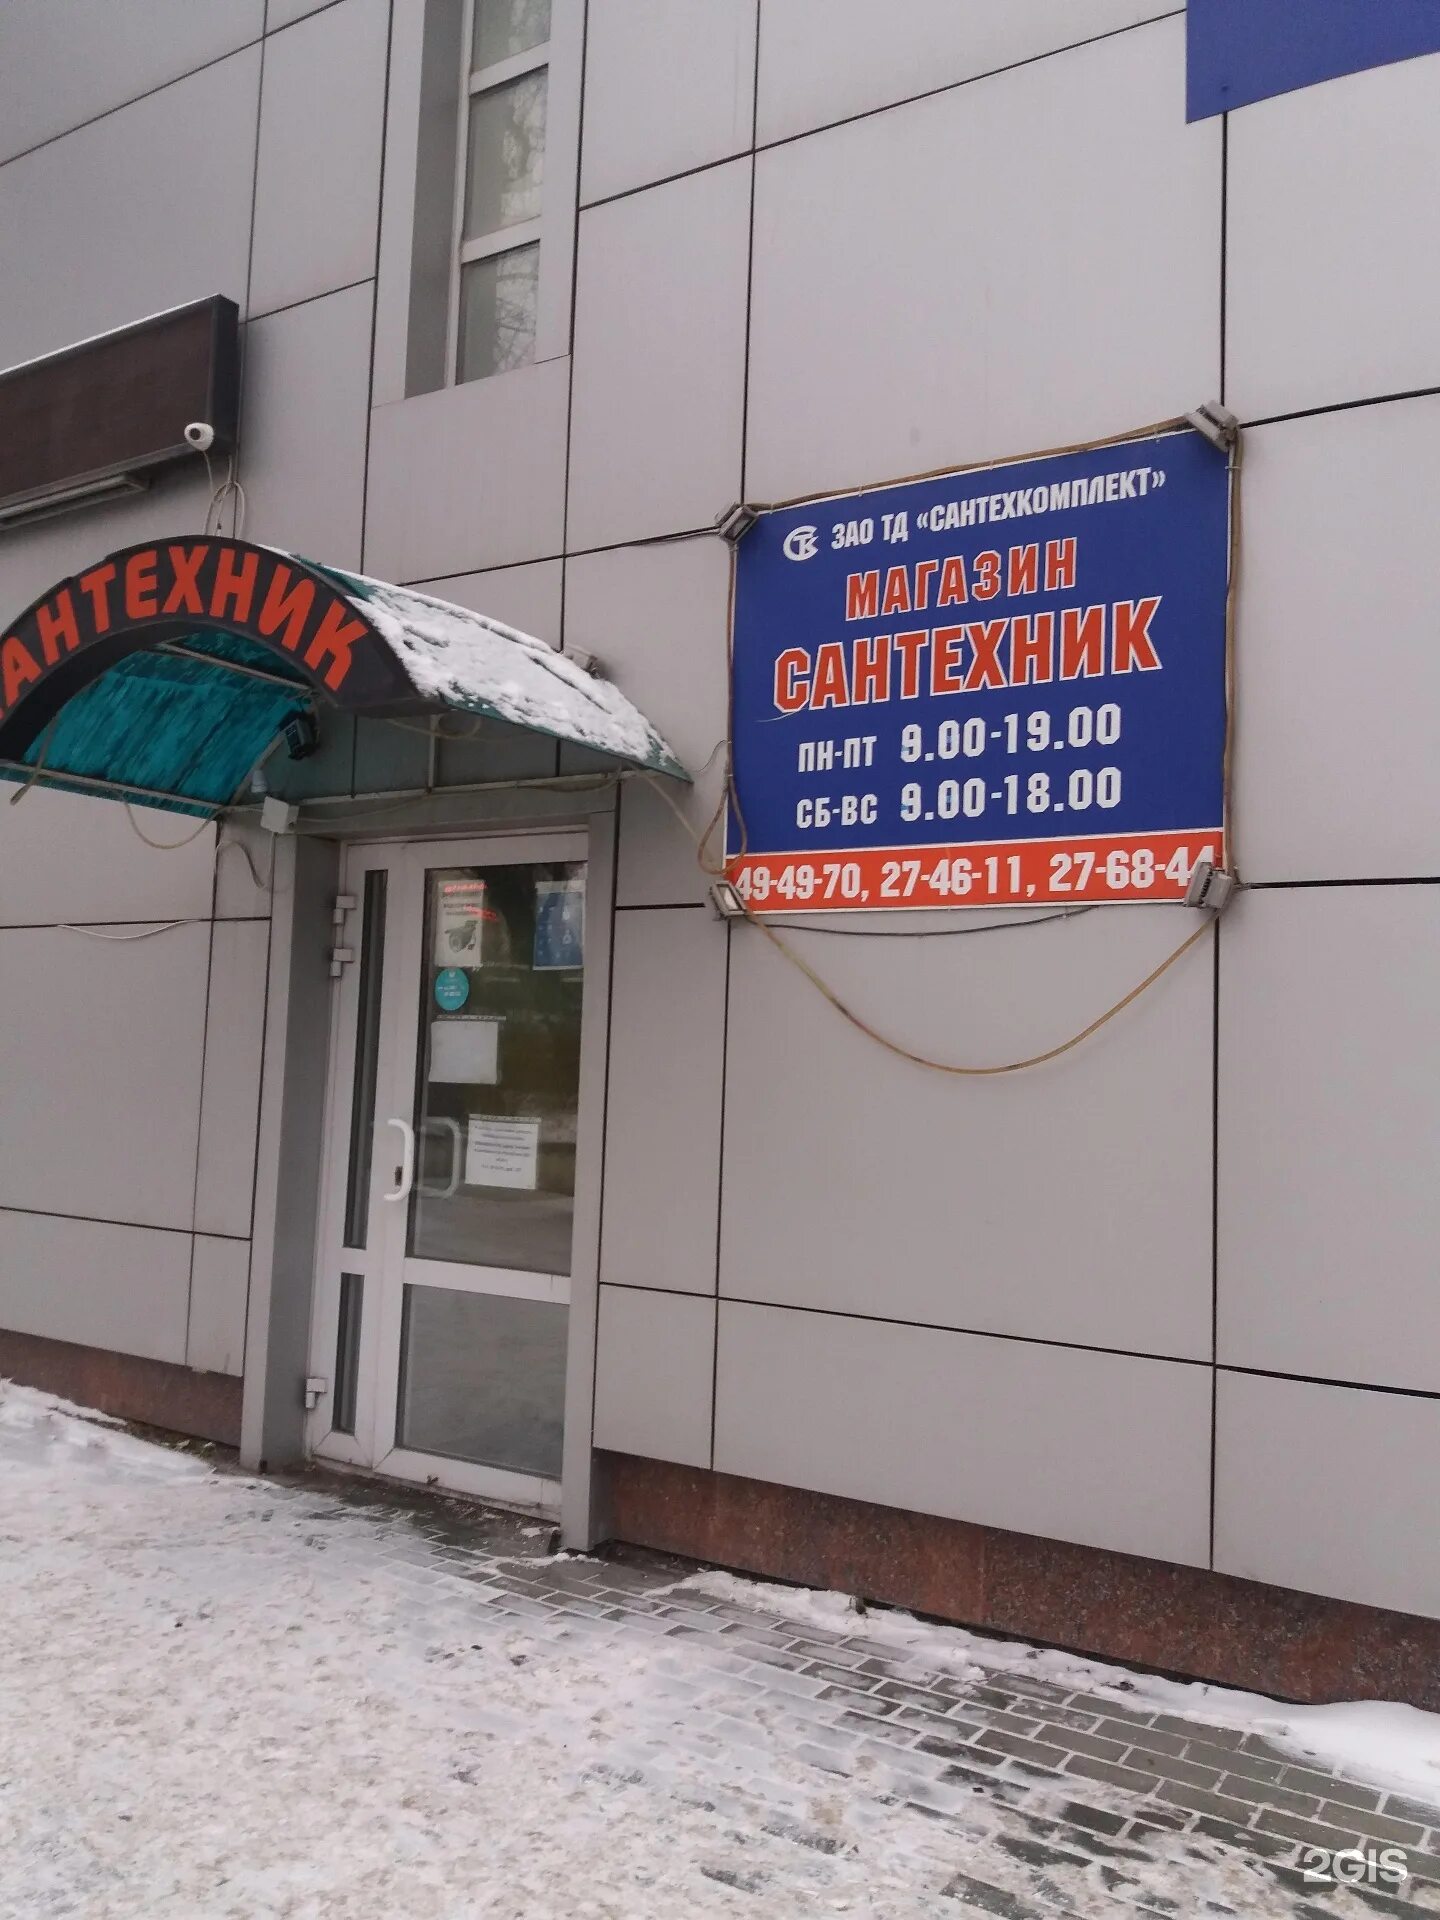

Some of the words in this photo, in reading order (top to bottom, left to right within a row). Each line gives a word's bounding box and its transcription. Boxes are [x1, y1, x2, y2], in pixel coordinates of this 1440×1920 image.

[830, 518, 874, 550] ЗАО
[880, 511, 909, 544] ТД
[916, 466, 1167, 533] «САНТЕХКОМПЛЕКТ»
[845, 536, 1078, 622] МАГАЗИН
[0, 545, 369, 719] АНТЕХНИК
[773, 595, 1163, 714] САНТЕХНИК
[797, 735, 878, 773] ПН-ПТ
[900, 702, 1122, 763] 9.00-19.00
[796, 793, 878, 829] СБ-ВС
[900, 766, 1122, 823] 9.00-18.00
[734, 863, 869, 902] 49-49-70,
[880, 855, 1036, 897] 27-46-11,
